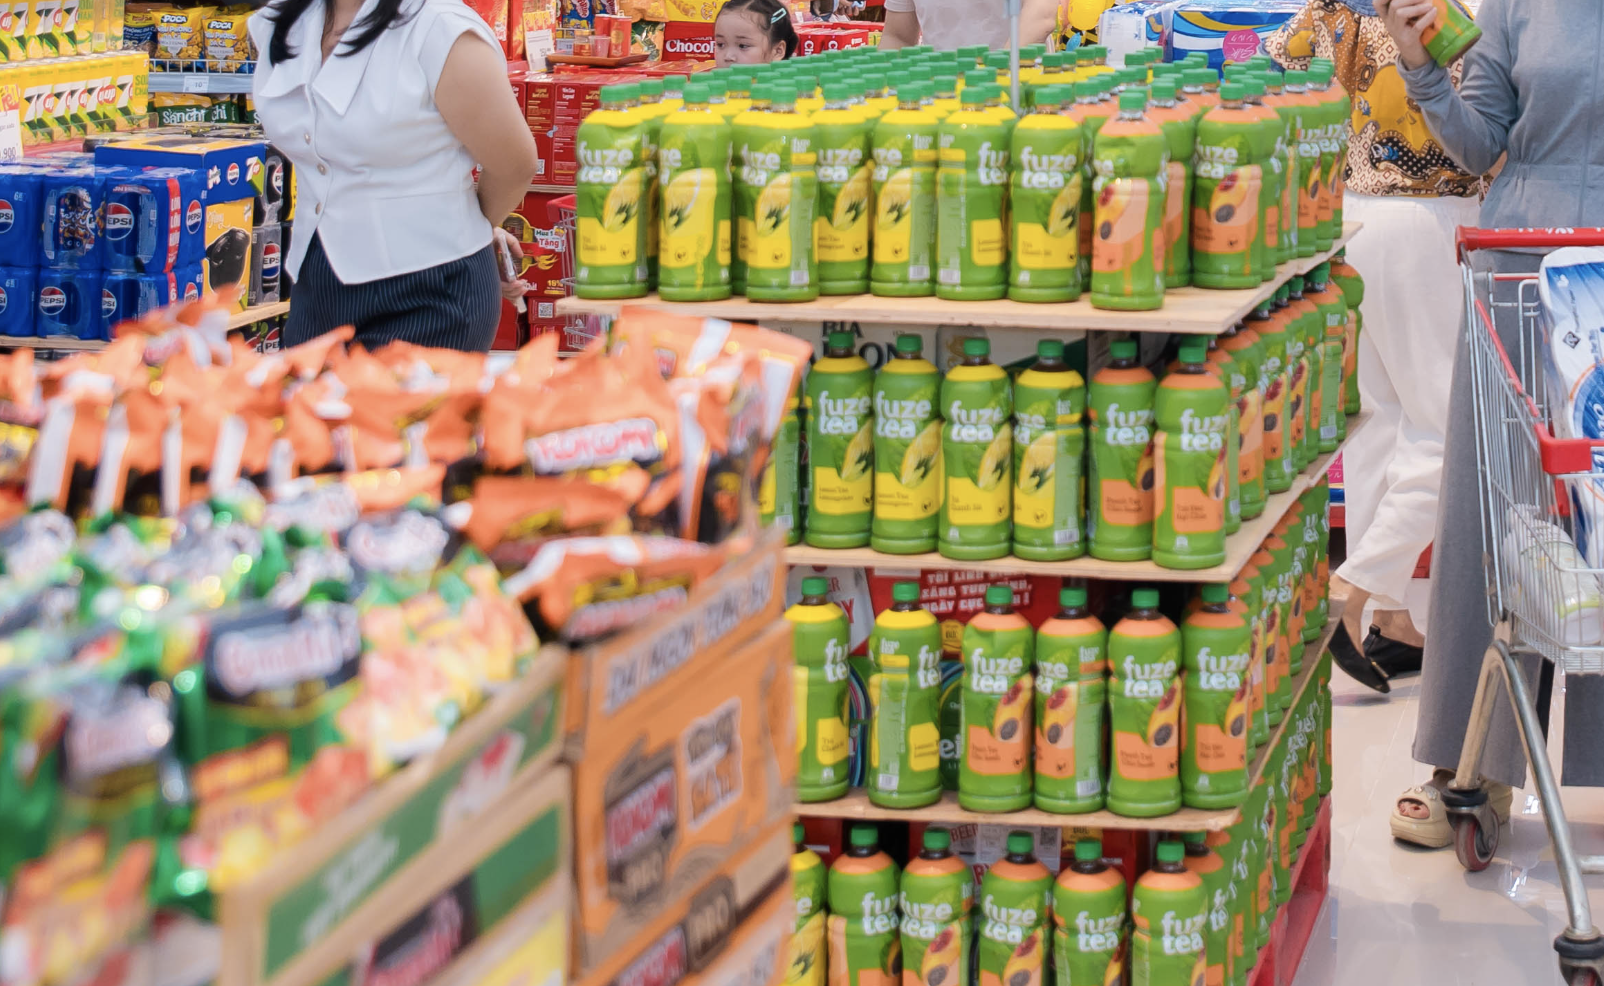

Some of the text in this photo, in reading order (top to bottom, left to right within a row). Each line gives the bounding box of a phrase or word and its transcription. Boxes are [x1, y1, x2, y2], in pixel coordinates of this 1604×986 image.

[162, 15, 186, 23] POCA
[209, 21, 232, 30] POCA
[579, 142, 634, 166] fuze
[1020, 146, 1077, 171] fuze
[1022, 169, 1064, 189] tea
[187, 214, 201, 222] PEPSI
[538, 238, 559, 249] Tặng
[818, 390, 871, 413] fuze
[876, 390, 932, 417] fuze
[818, 414, 858, 435] tea
[877, 416, 917, 439] tea
[951, 424, 994, 443] tea
[1106, 424, 1150, 446] tea
[971, 649, 1023, 676] fuze
[1123, 655, 1176, 681] fuze
[1198, 647, 1250, 673] fuze
[972, 671, 1009, 693] tea
[1124, 678, 1165, 698] tea
[1200, 670, 1241, 690] tea
[984, 894, 1037, 926] fuze
